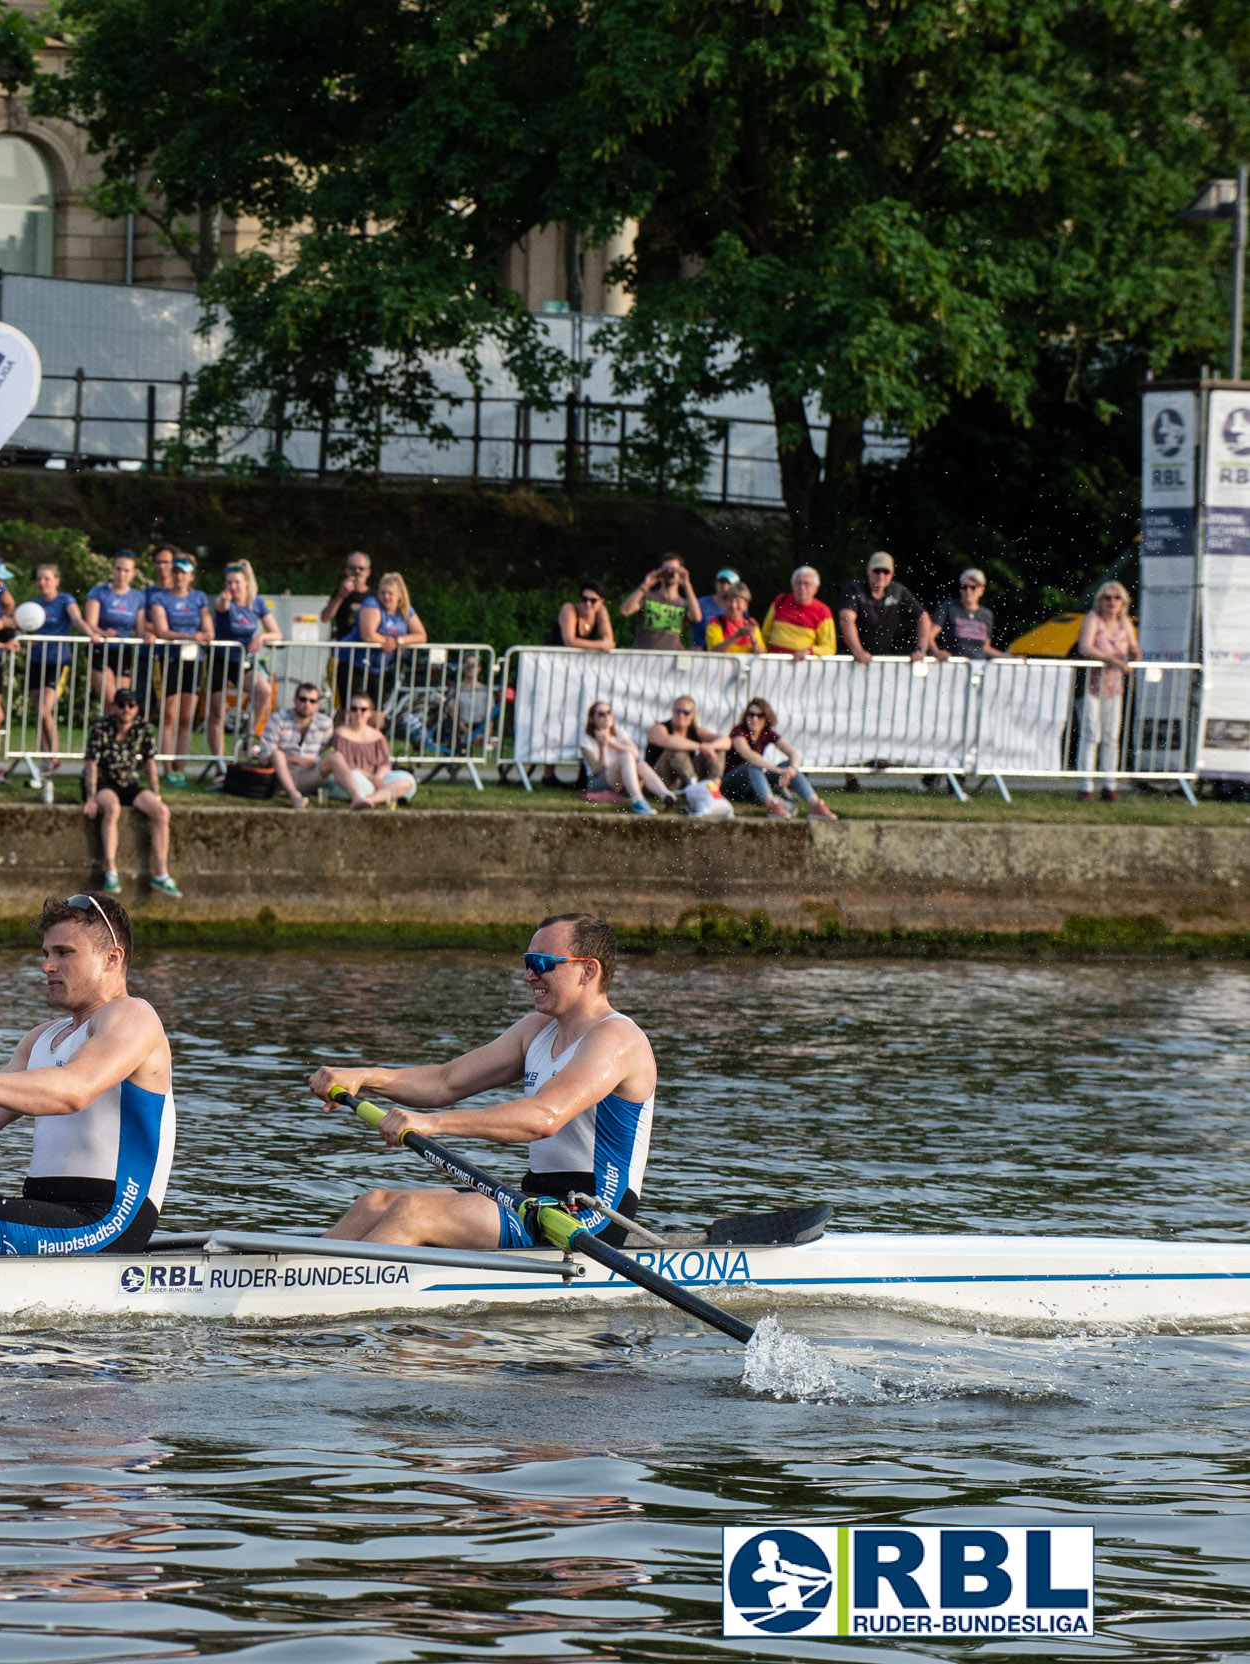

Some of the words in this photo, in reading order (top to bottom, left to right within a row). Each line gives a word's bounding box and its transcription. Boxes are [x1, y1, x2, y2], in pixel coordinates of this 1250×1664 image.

[1152, 469, 1185, 486] RBL
[1219, 468, 1250, 485] RB
[497, 1191, 516, 1211] RBL
[37, 1176, 140, 1255] Hauptstadtsprinter
[149, 1266, 203, 1287] RBL
[210, 1265, 410, 1288] RUDER-BUNDESLIGA
[148, 1286, 203, 1294] RUDER-BUNDESLIGA
